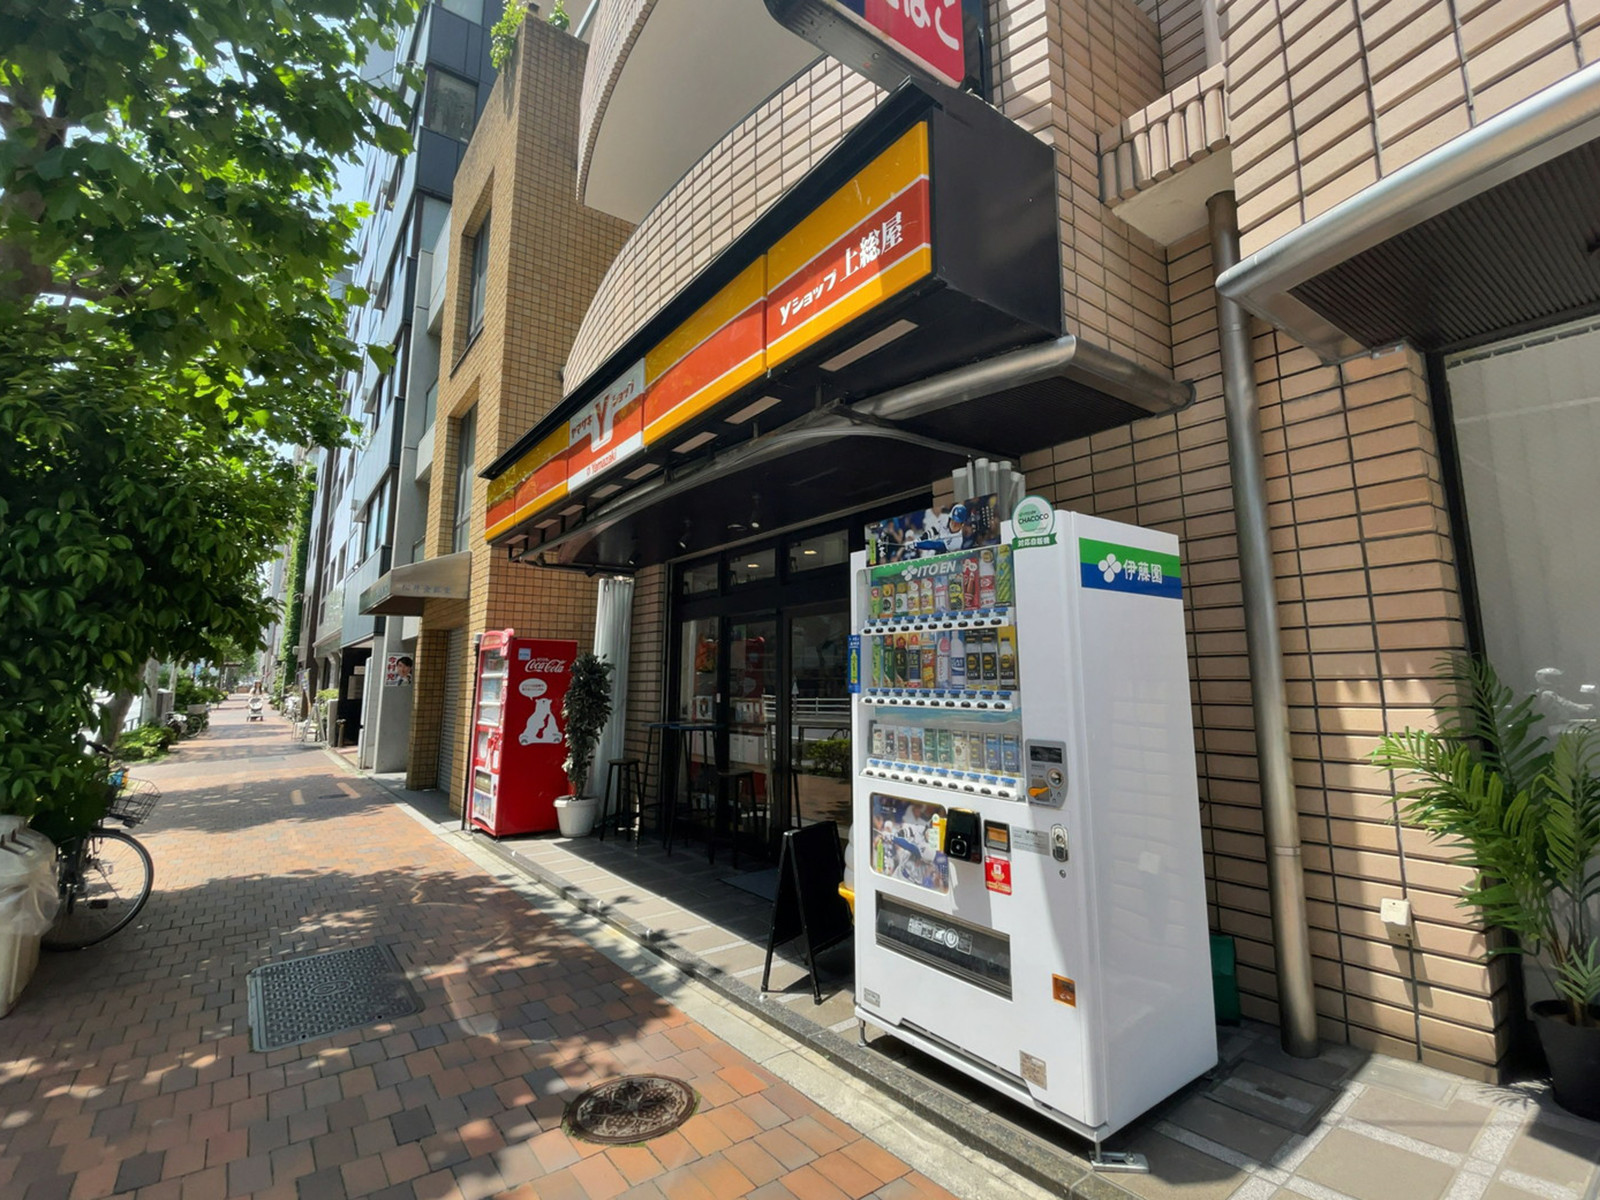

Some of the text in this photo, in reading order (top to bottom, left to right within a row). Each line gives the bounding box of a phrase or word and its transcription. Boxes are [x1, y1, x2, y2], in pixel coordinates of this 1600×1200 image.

[840, 211, 904, 282] 上総屋
[571, 379, 635, 442] ヤマザキ Y ショップ
[591, 448, 618, 474] Yamazaki
[1017, 512, 1050, 526] CHACOCO
[916, 560, 957, 578] ITO EN
[1123, 559, 1164, 585] 伊藤園
[525, 657, 568, 673] Coca-Cola
